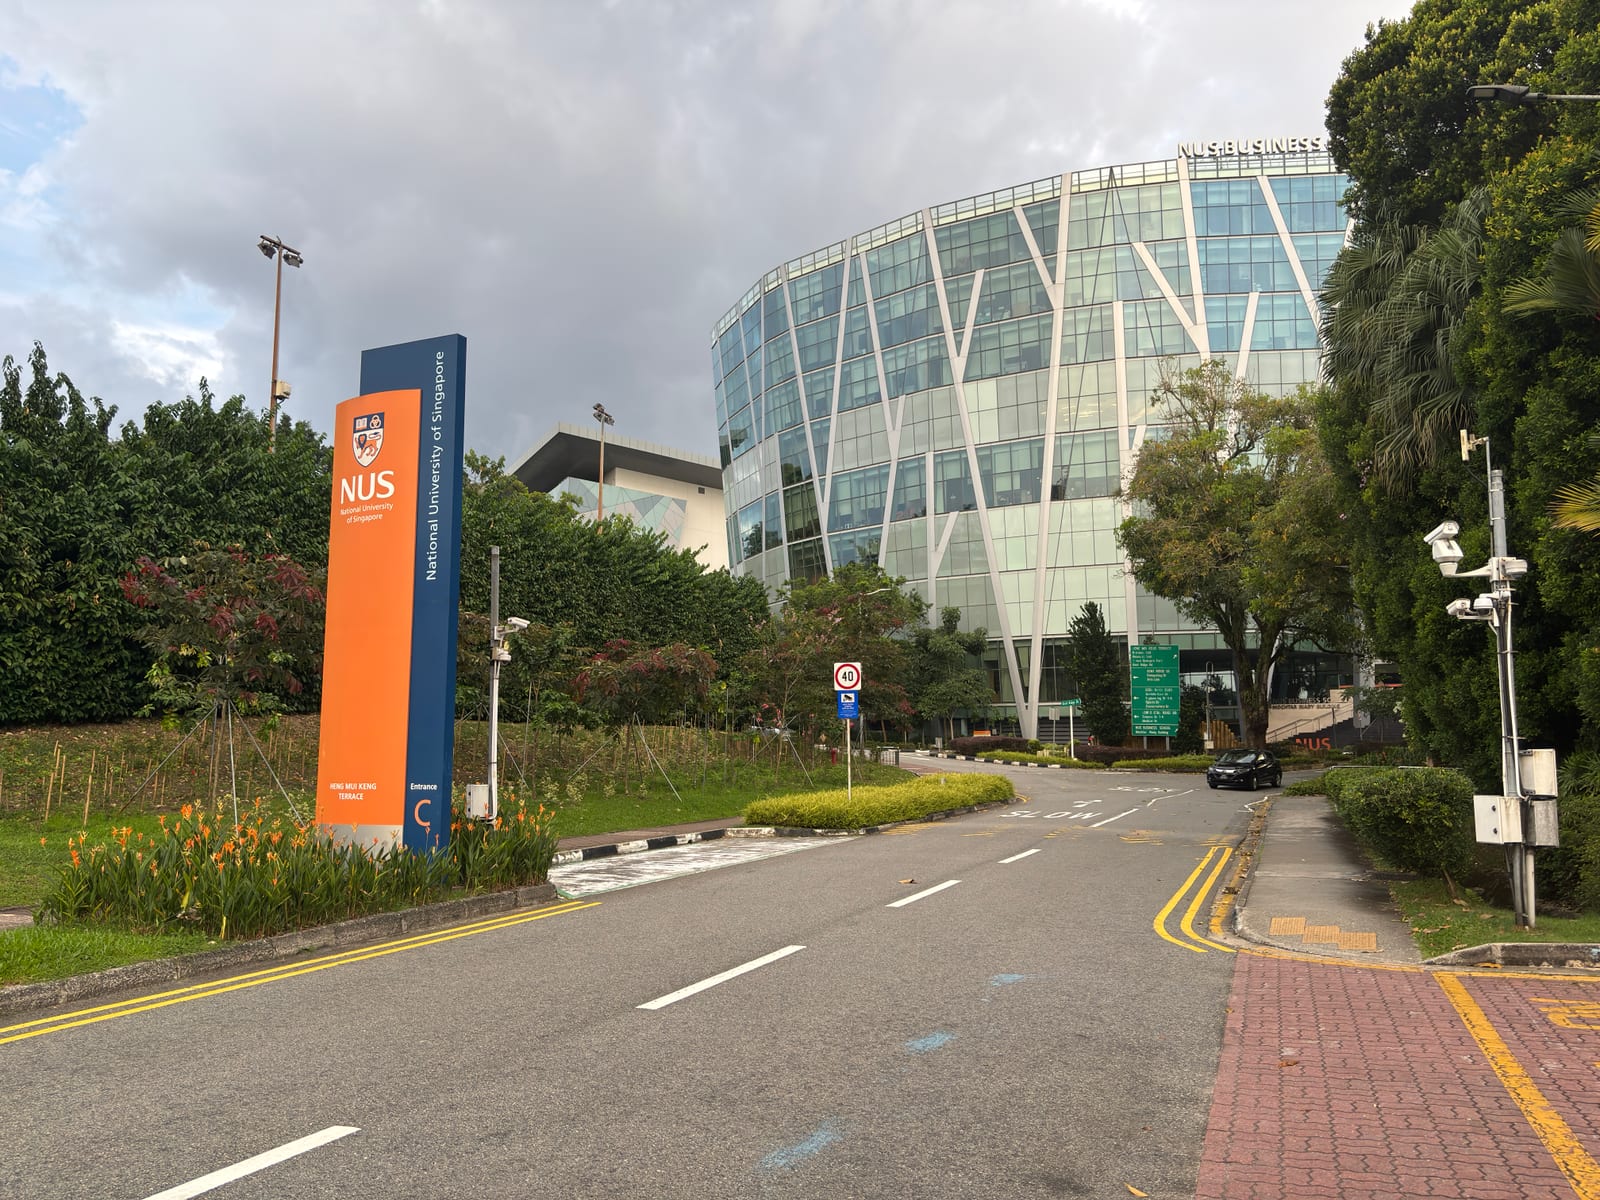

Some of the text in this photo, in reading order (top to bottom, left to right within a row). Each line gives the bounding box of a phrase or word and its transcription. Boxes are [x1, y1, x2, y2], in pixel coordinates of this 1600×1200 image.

[1178, 141, 1219, 158] NUS
[1223, 137, 1321, 156] BUSINESS
[426, 351, 446, 580] National University of Singapore
[340, 470, 395, 505] NUS
[340, 503, 394, 515] National University
[353, 514, 383, 523] Singapore
[842, 671, 853, 681] 40
[338, 792, 363, 800] TERRACE
[414, 799, 431, 827] C
[1000, 811, 1104, 820] SLOW
